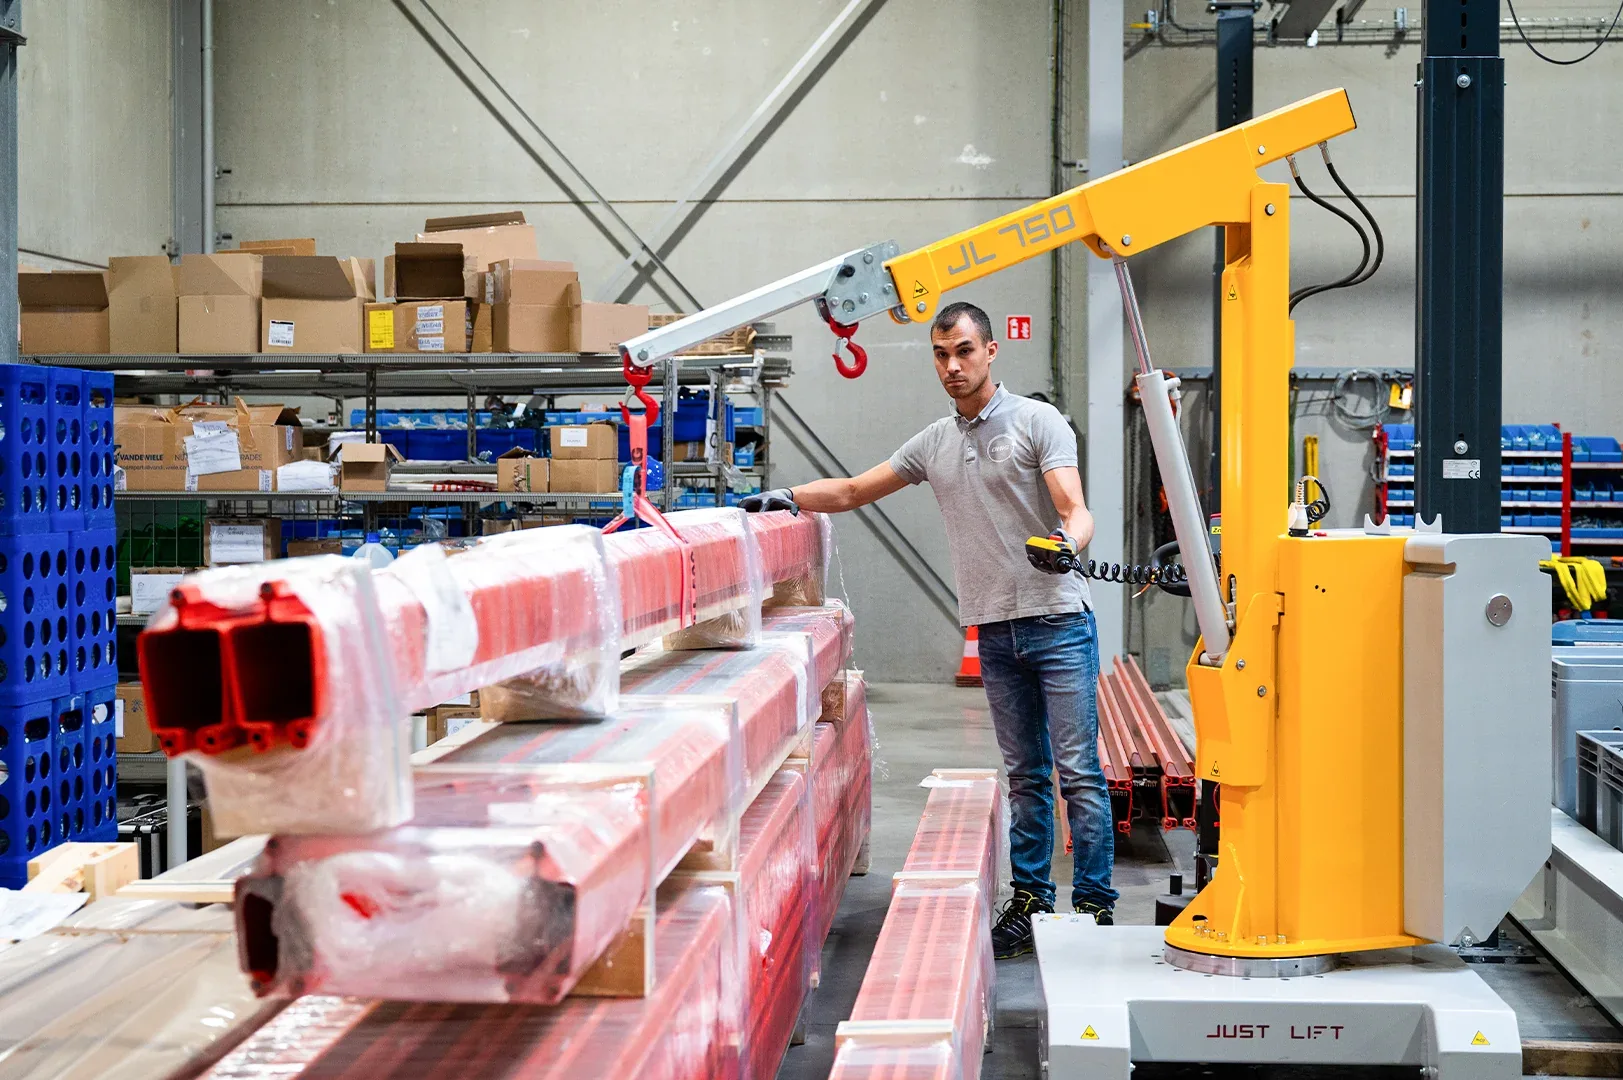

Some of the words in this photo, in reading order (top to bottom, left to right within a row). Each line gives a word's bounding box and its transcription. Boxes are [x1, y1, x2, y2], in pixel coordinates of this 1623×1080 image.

[948, 241, 996, 275] JL
[998, 204, 1076, 247] 750
[1206, 1024, 1270, 1039] JUST
[1291, 1025, 1344, 1039] LIFT
